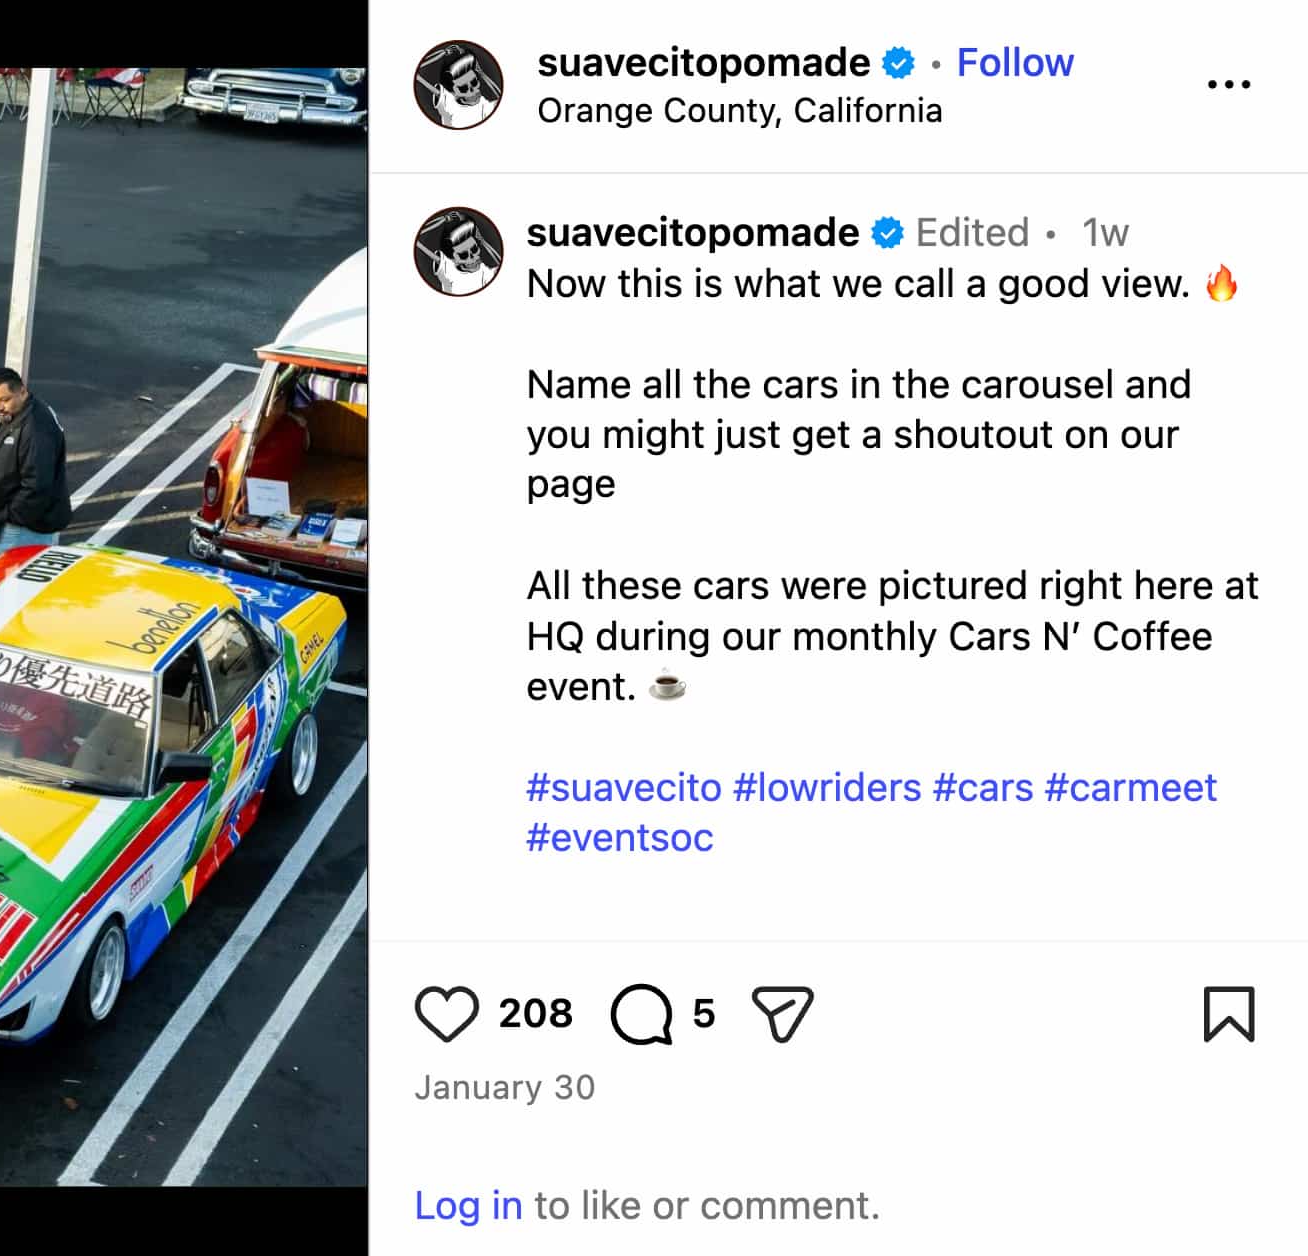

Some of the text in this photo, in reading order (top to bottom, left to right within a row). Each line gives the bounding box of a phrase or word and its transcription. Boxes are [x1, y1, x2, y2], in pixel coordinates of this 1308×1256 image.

[16, 551, 83, 583] RIELLO
[105, 602, 201, 655] benetton
[299, 632, 325, 664] CAMEL
